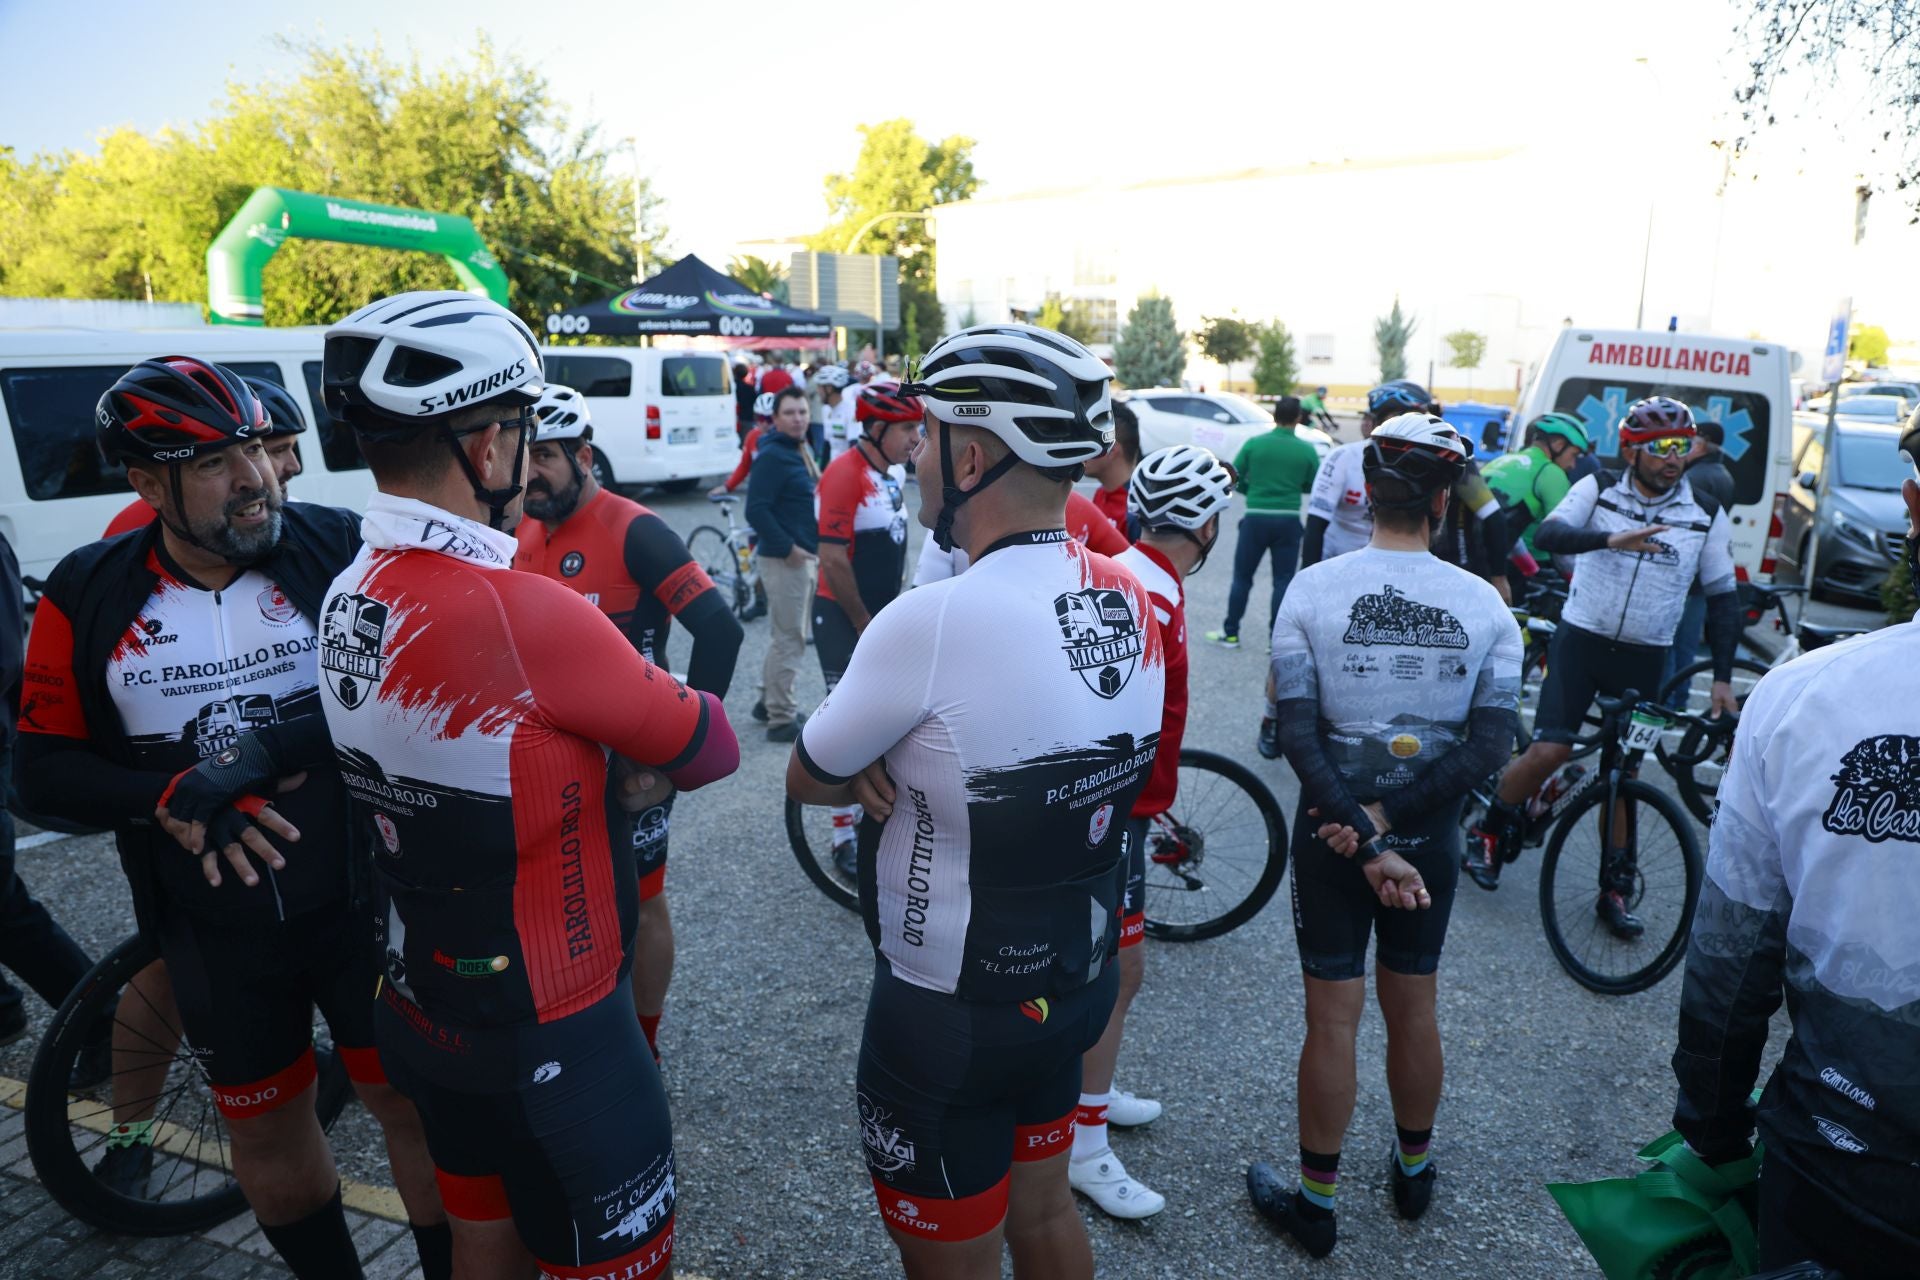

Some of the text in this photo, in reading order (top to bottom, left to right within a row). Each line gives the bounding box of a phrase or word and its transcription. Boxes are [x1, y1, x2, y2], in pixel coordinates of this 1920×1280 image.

[326, 202, 438, 233] Mancomunidad
[1588, 342, 1751, 377] AMBULANCIA
[417, 358, 526, 415] S-WORKS
[957, 407, 987, 415] ABUS
[128, 633, 178, 649] VIATOR
[1344, 620, 1468, 648] La Casona de Manuela
[123, 635, 319, 687] P.C. FAROLILLO ROJO
[321, 645, 382, 679] MICHELI
[1066, 633, 1142, 668] MICHELI
[160, 661, 296, 698] VALVERDE DE LEGANÉS
[1045, 746, 1157, 805] P.C. FAROLILLO ROJO
[393, 788, 438, 808] ROJO
[1069, 789, 1103, 811] VALVERDE
[1103, 784, 1112, 795] DE
[1828, 788, 1920, 838] La Cas
[561, 781, 594, 960] FAROLILLO ROJO
[903, 785, 935, 947] FAROLILLO ROJO
[999, 942, 1050, 958] Chuches
[222, 1087, 279, 1107] ROJO
[1027, 1129, 1065, 1148] P.C.
[605, 1199, 625, 1221] El
[885, 1206, 940, 1232] VIATOR
